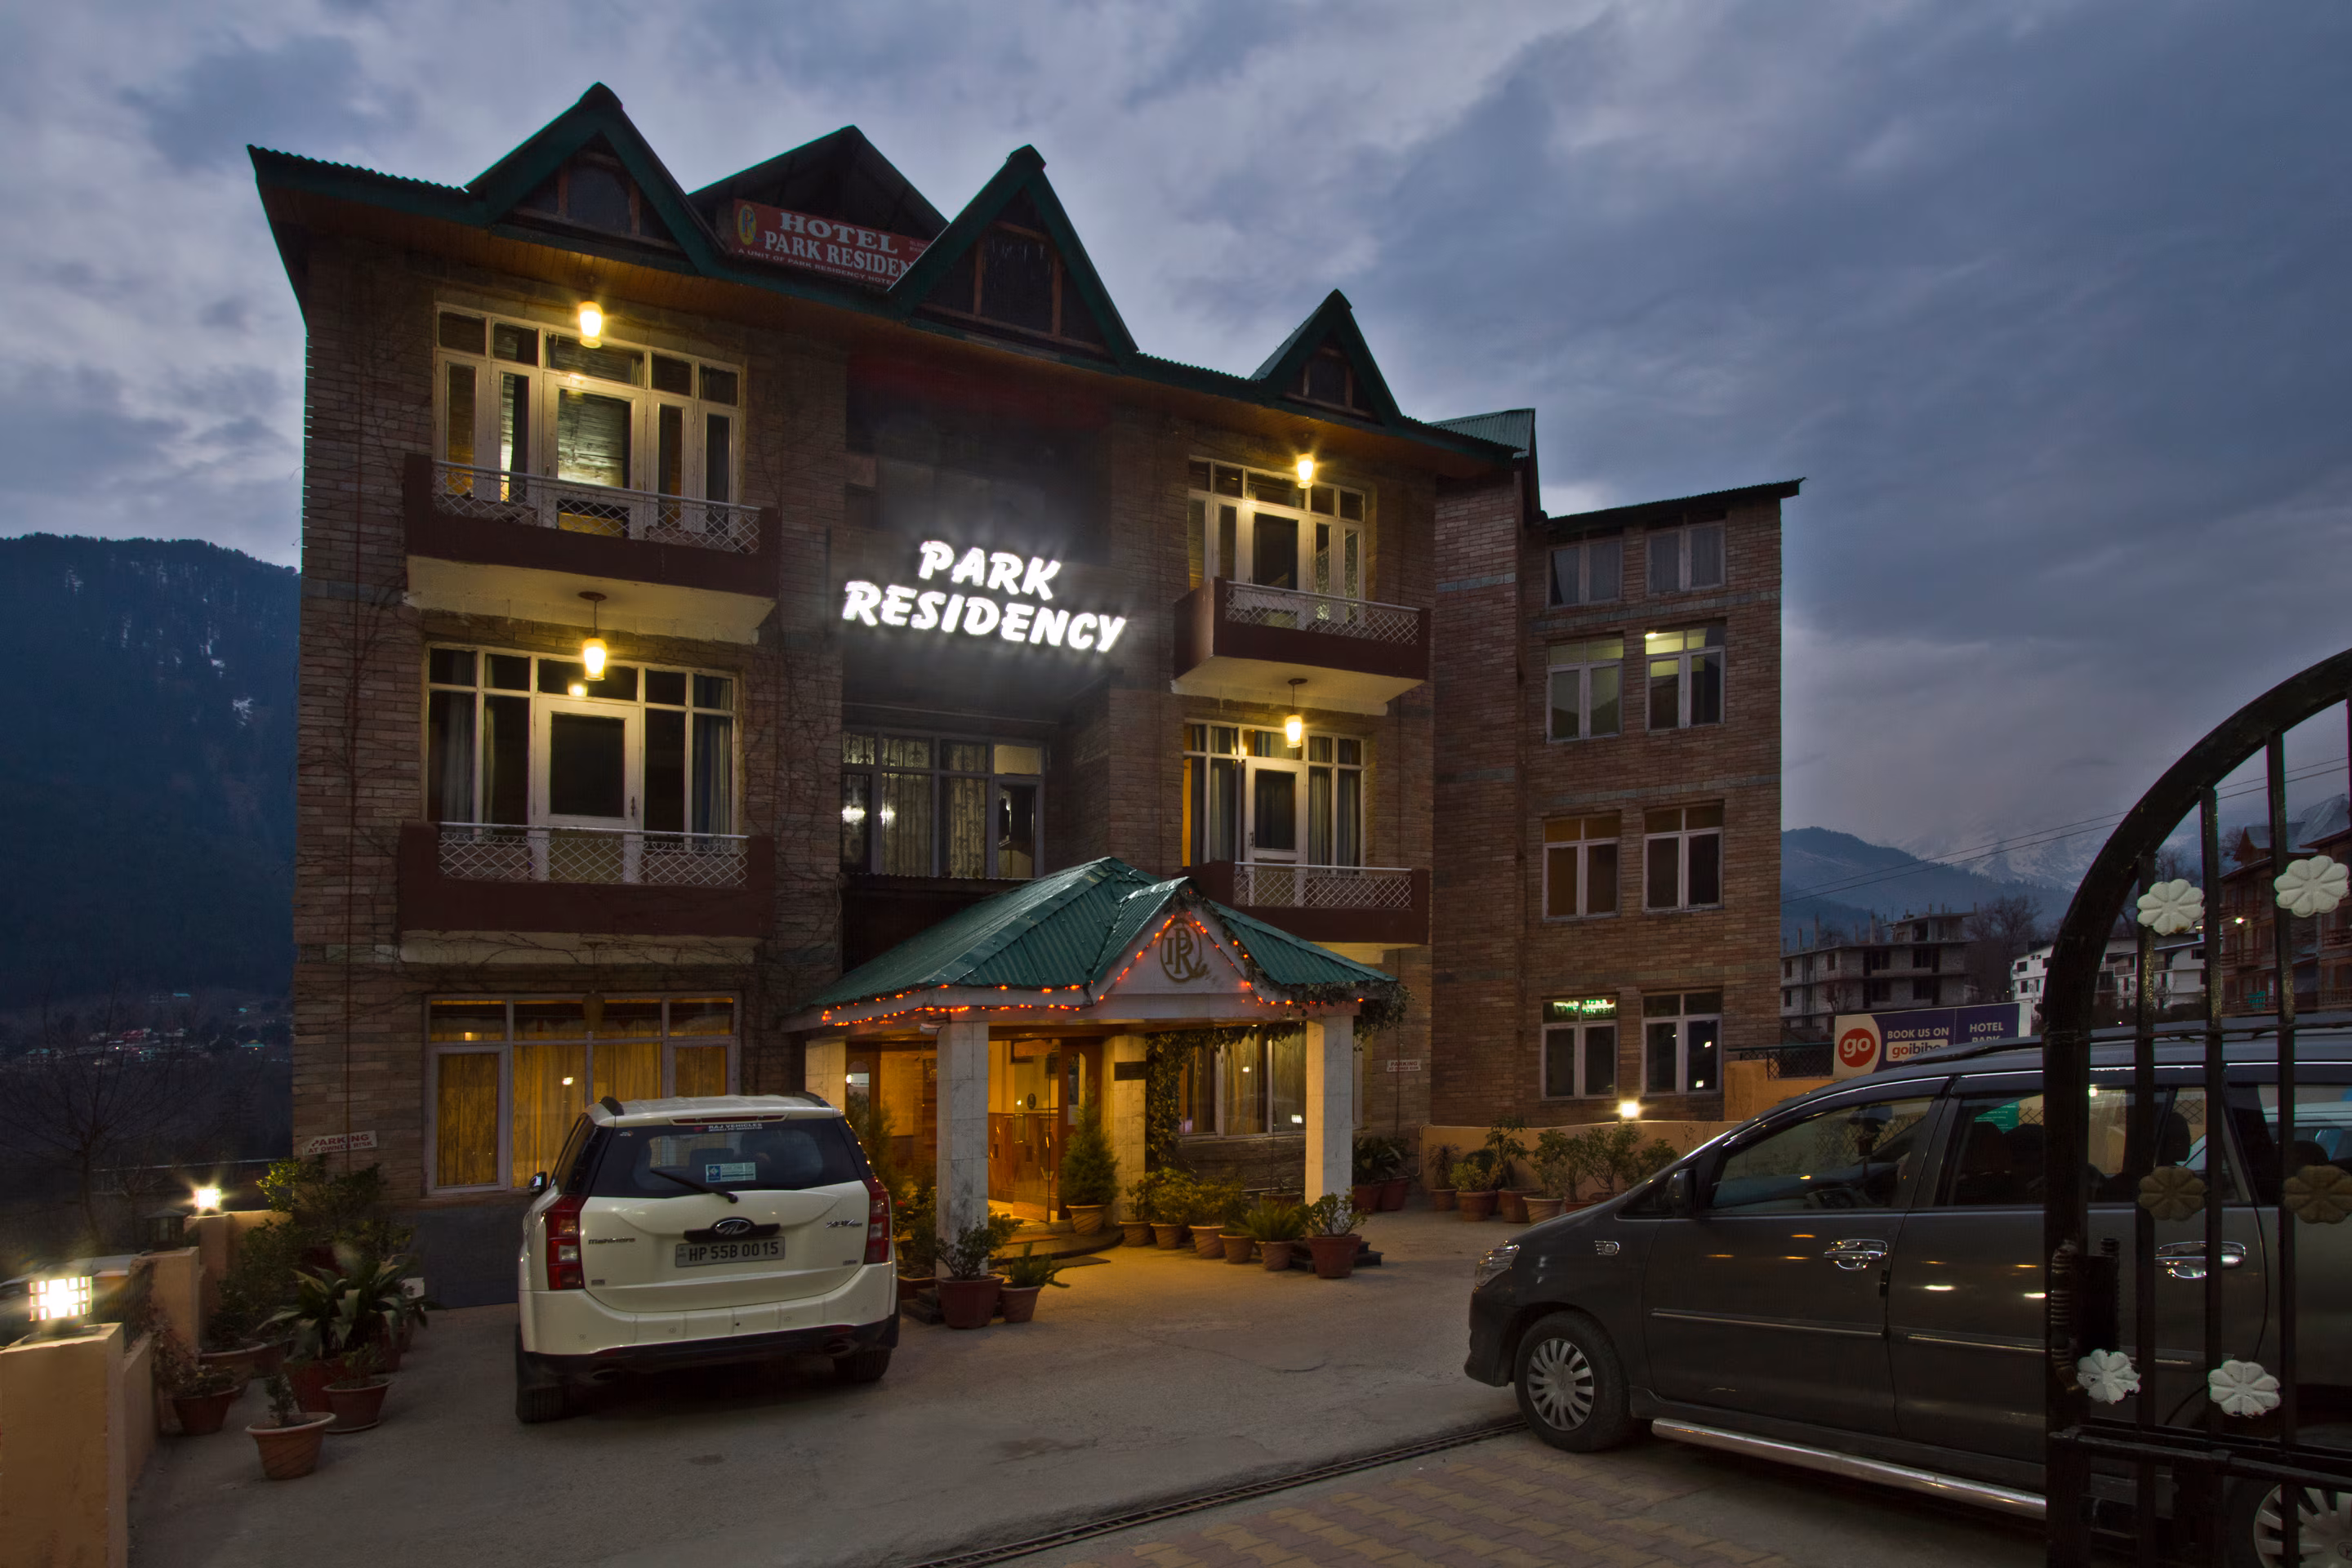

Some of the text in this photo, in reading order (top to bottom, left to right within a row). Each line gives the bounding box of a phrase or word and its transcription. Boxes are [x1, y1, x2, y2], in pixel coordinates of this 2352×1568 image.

[764, 230, 822, 261] PARK
[780, 212, 898, 254] HOTEL
[747, 250, 770, 259] UNIT
[788, 258, 811, 268] PARK
[814, 264, 866, 279] RESIDENCY
[919, 540, 1062, 601] PARK
[842, 580, 1127, 653] RESIDENCY
[1887, 1027, 1949, 1040] BOOK US ON
[1969, 1022, 2004, 1033] HOTEL
[1843, 1037, 1871, 1058] go
[688, 1241, 779, 1262] HP 55B 0015
